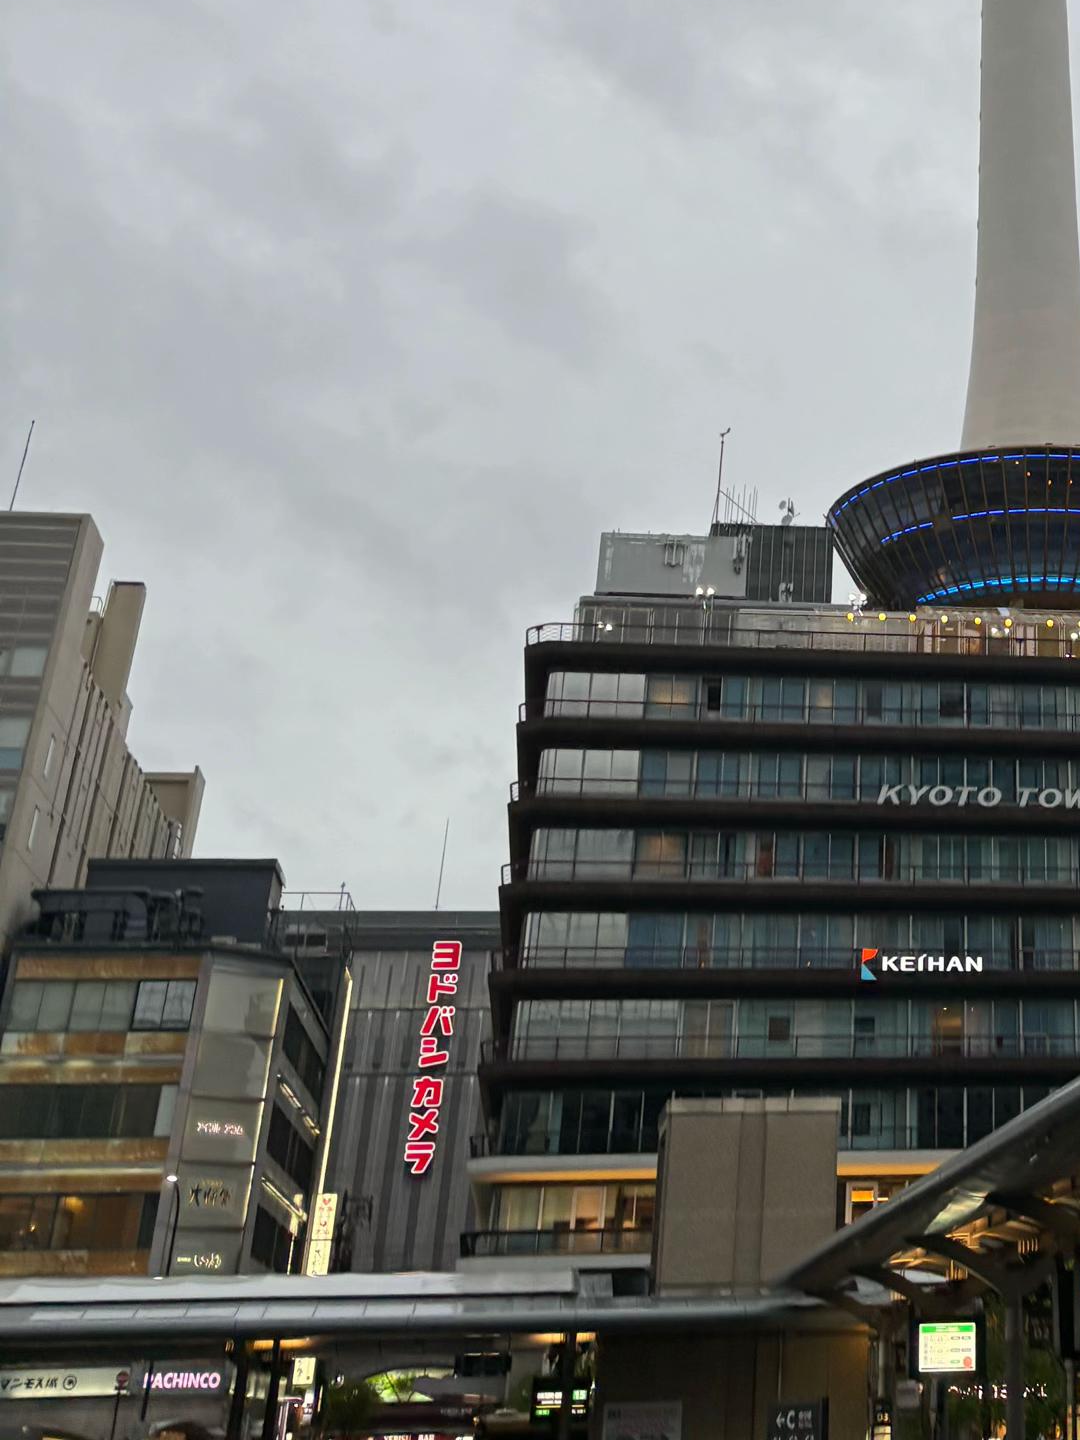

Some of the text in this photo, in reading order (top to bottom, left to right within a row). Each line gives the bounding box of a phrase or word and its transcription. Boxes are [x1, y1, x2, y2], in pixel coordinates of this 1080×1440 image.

[878, 784, 1001, 807] KYOTO
[881, 953, 983, 972] KEIHAN
[403, 940, 462, 1175] ヨドバシカメラ
[143, 1372, 221, 1389] PACHINCO
